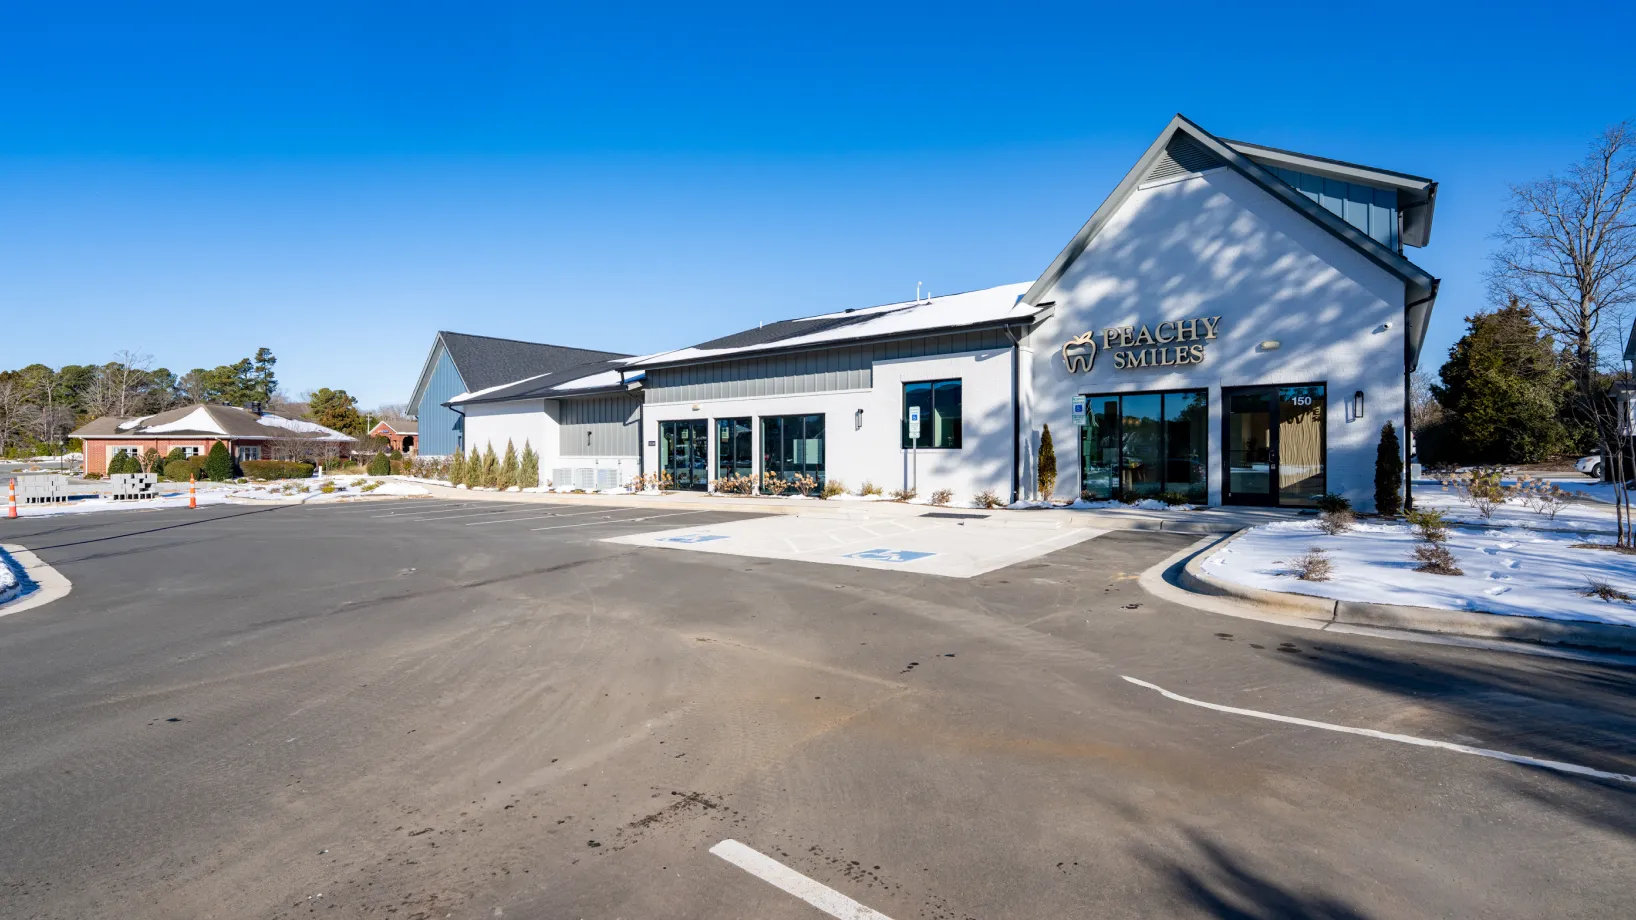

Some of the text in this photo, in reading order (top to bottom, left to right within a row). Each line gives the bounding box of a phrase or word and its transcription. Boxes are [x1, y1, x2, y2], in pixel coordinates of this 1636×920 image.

[1102, 315, 1222, 350] PEACHY
[1114, 344, 1204, 369] SMILES
[1291, 396, 1312, 406] 150
